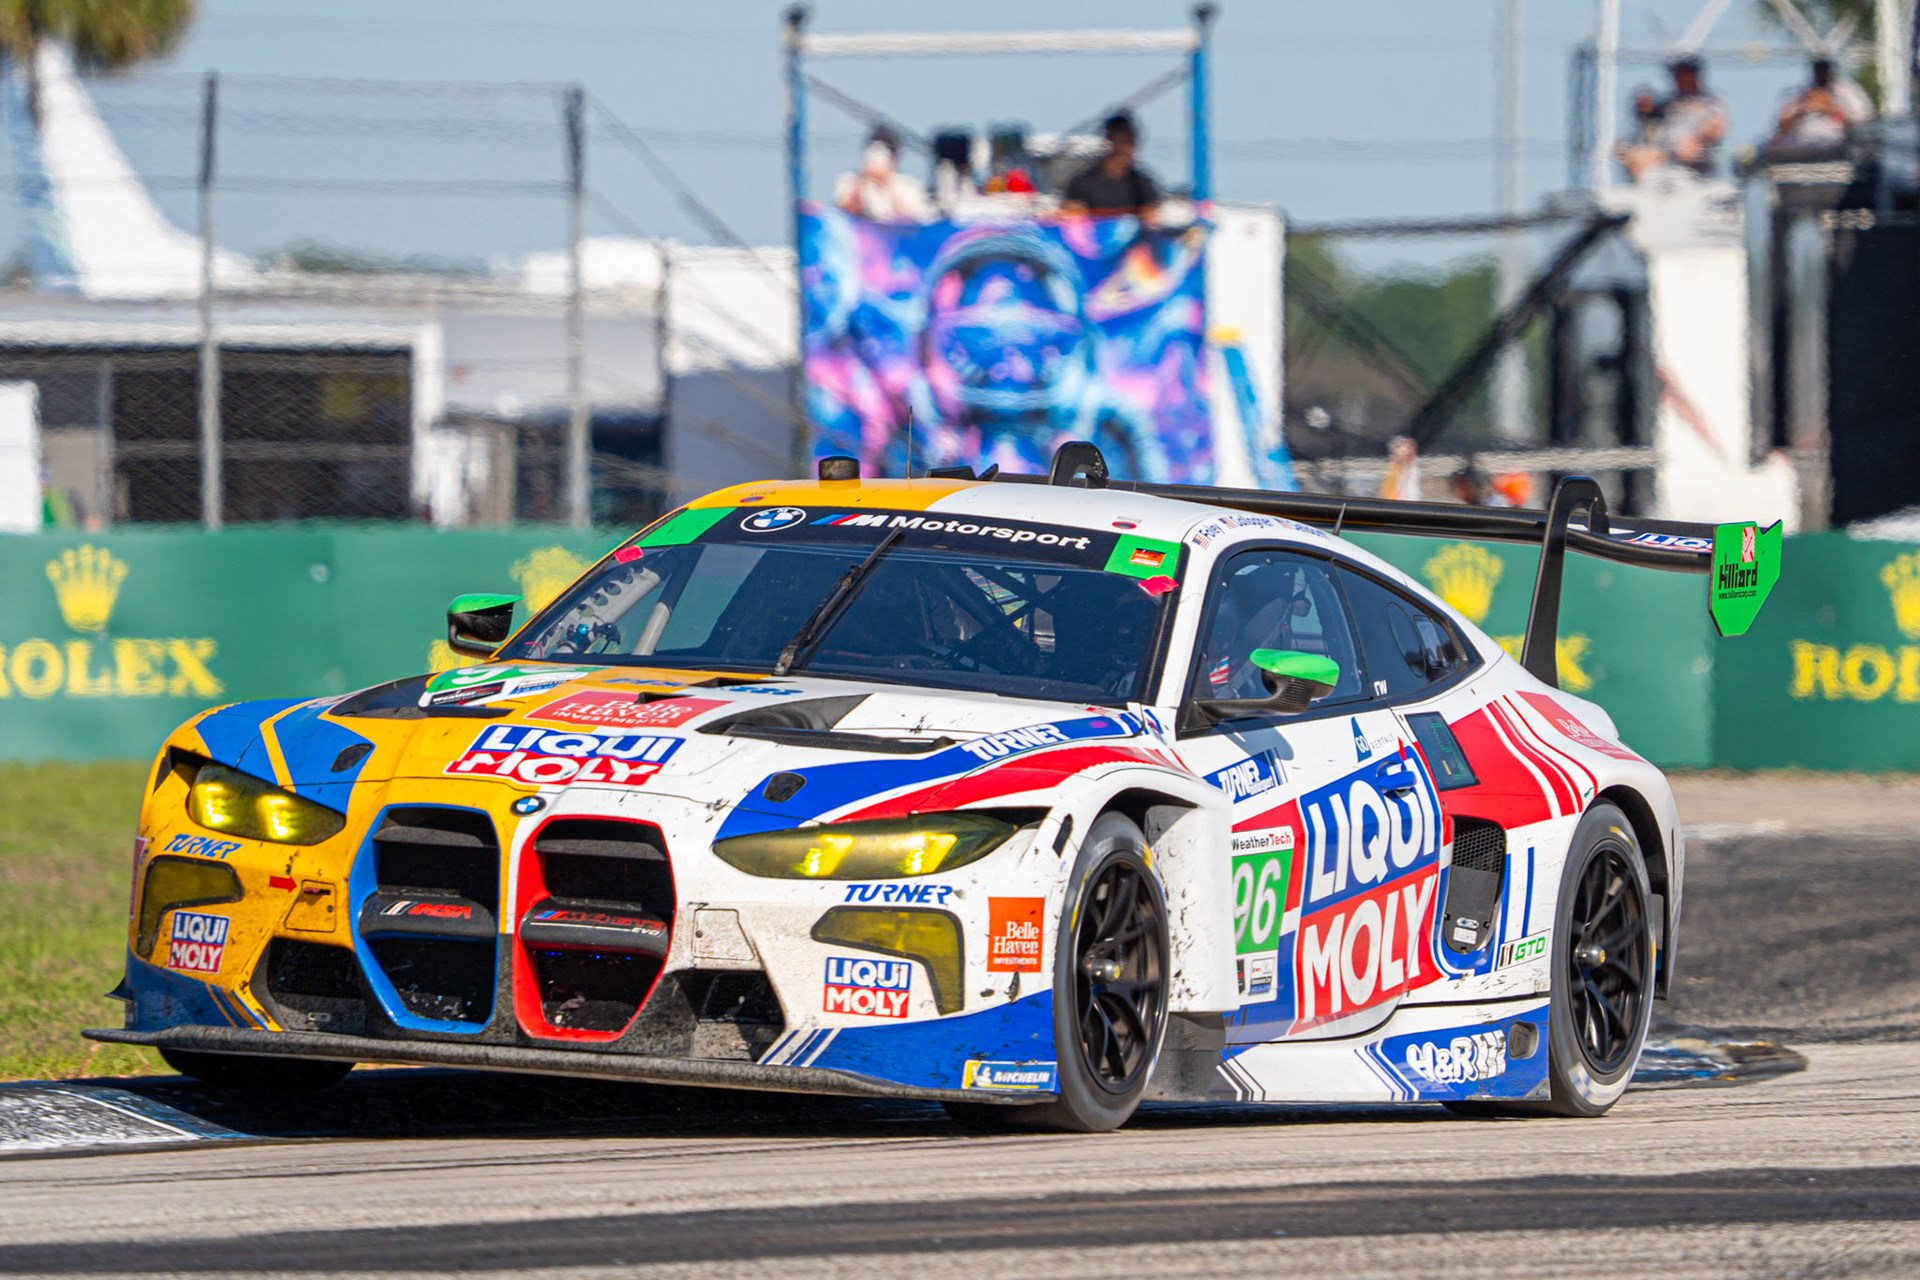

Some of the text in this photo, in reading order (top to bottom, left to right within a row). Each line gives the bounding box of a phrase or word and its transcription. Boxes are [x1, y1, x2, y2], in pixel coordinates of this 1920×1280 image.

[888, 516, 1091, 550] Motorsport
[1647, 533, 1713, 549] LIQ
[1718, 558, 1758, 590] Hilliard
[0, 637, 224, 699] OLEX
[552, 711, 669, 724] INVESTMENTS
[557, 702, 681, 719] Haven
[601, 700, 693, 713] Belle
[481, 726, 677, 762] LIQUI
[961, 723, 1071, 762] TURNER
[456, 752, 661, 783] MOLY
[1217, 758, 1262, 801] TURNER
[1308, 757, 1436, 903] LIQUI
[163, 833, 242, 859] TURNER
[844, 884, 953, 904] TURNER
[1232, 858, 1281, 945] 96
[407, 902, 472, 920] IMSA
[173, 913, 228, 943] LIQUI
[631, 927, 662, 937] EVO
[1006, 921, 1040, 940] Belle
[170, 942, 223, 971] MOLY
[992, 936, 1039, 955] Haven
[1301, 873, 1438, 1024] MOLY
[1514, 936, 1547, 961] GTD
[827, 958, 910, 988] LIQUI
[825, 986, 909, 1017] MOLY
[1406, 1032, 1492, 1084] H&R
[993, 1070, 1051, 1083] MICHELIN
